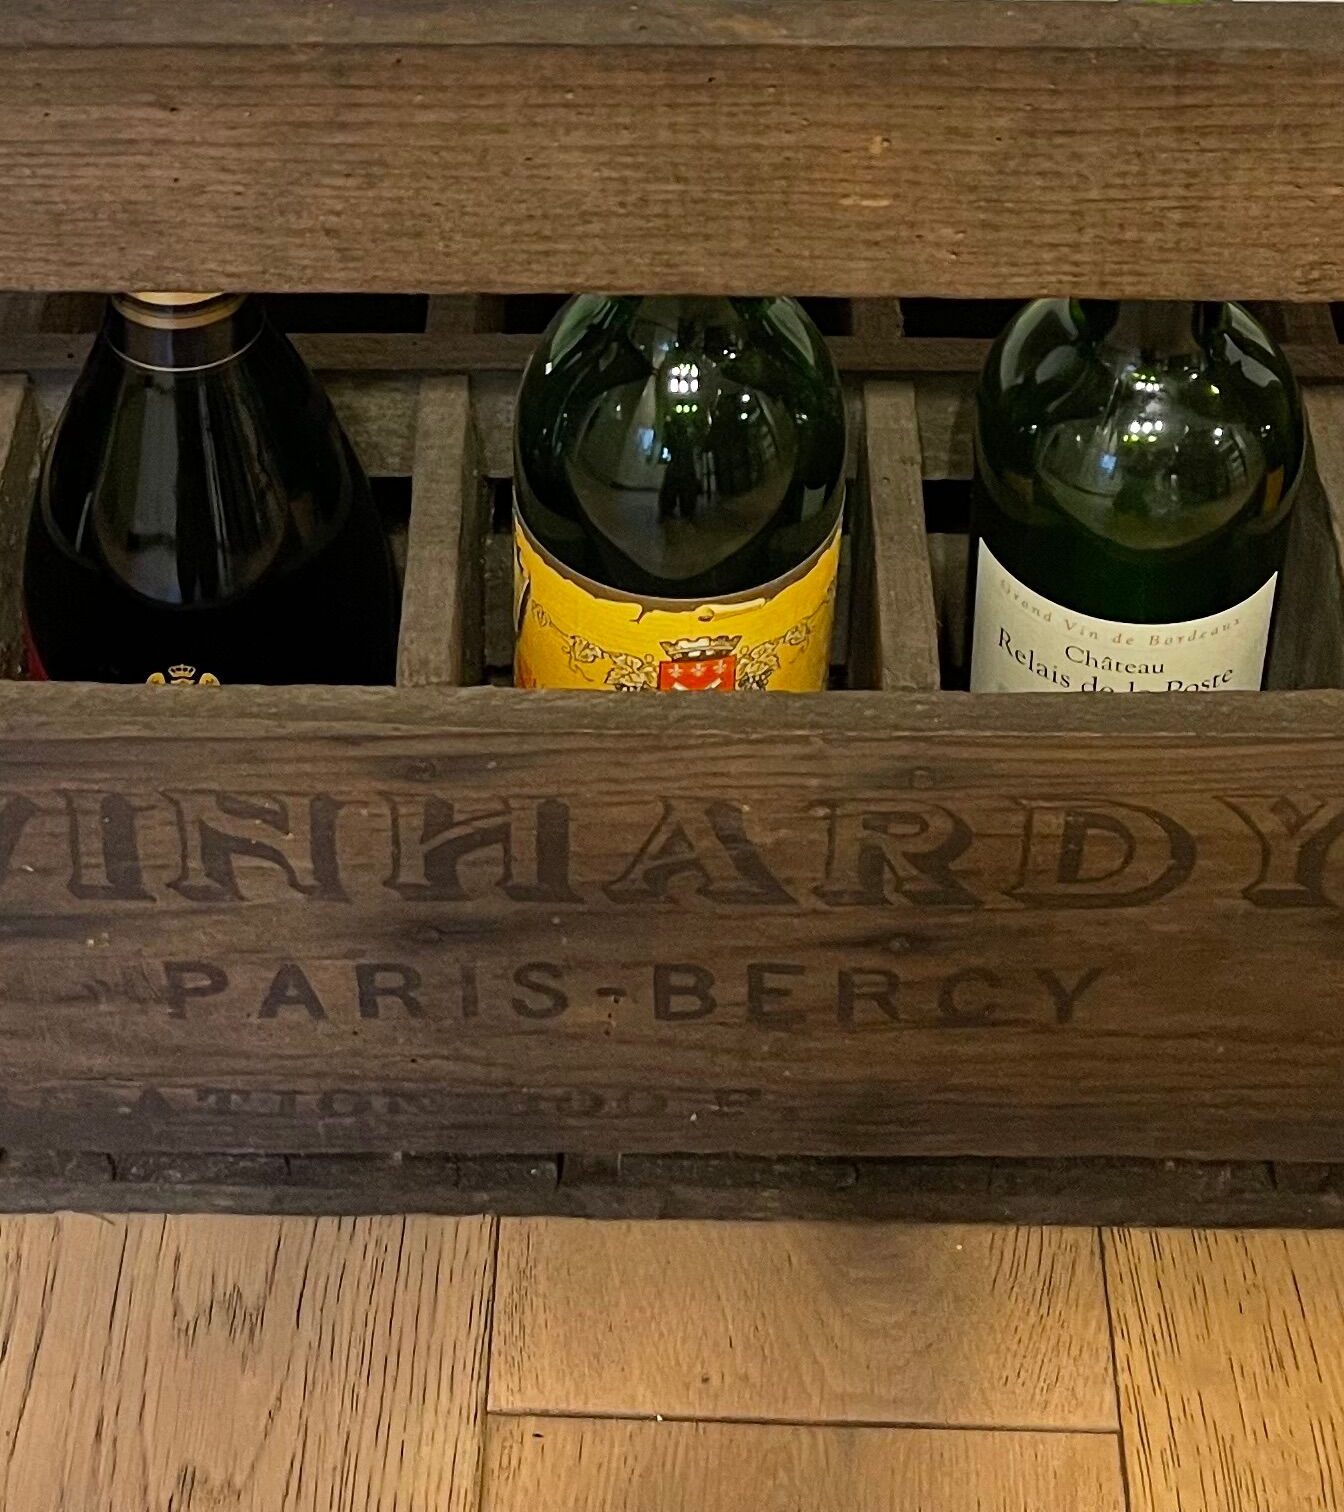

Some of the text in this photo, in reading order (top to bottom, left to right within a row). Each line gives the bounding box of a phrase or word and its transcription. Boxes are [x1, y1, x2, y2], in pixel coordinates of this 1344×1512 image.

[1000, 579, 1240, 646] Grand Vin de Bordeaux
[999, 626, 1070, 689] Relais
[1065, 645, 1165, 675] Château
[164, 961, 1104, 1028] PARIS-BERCY
